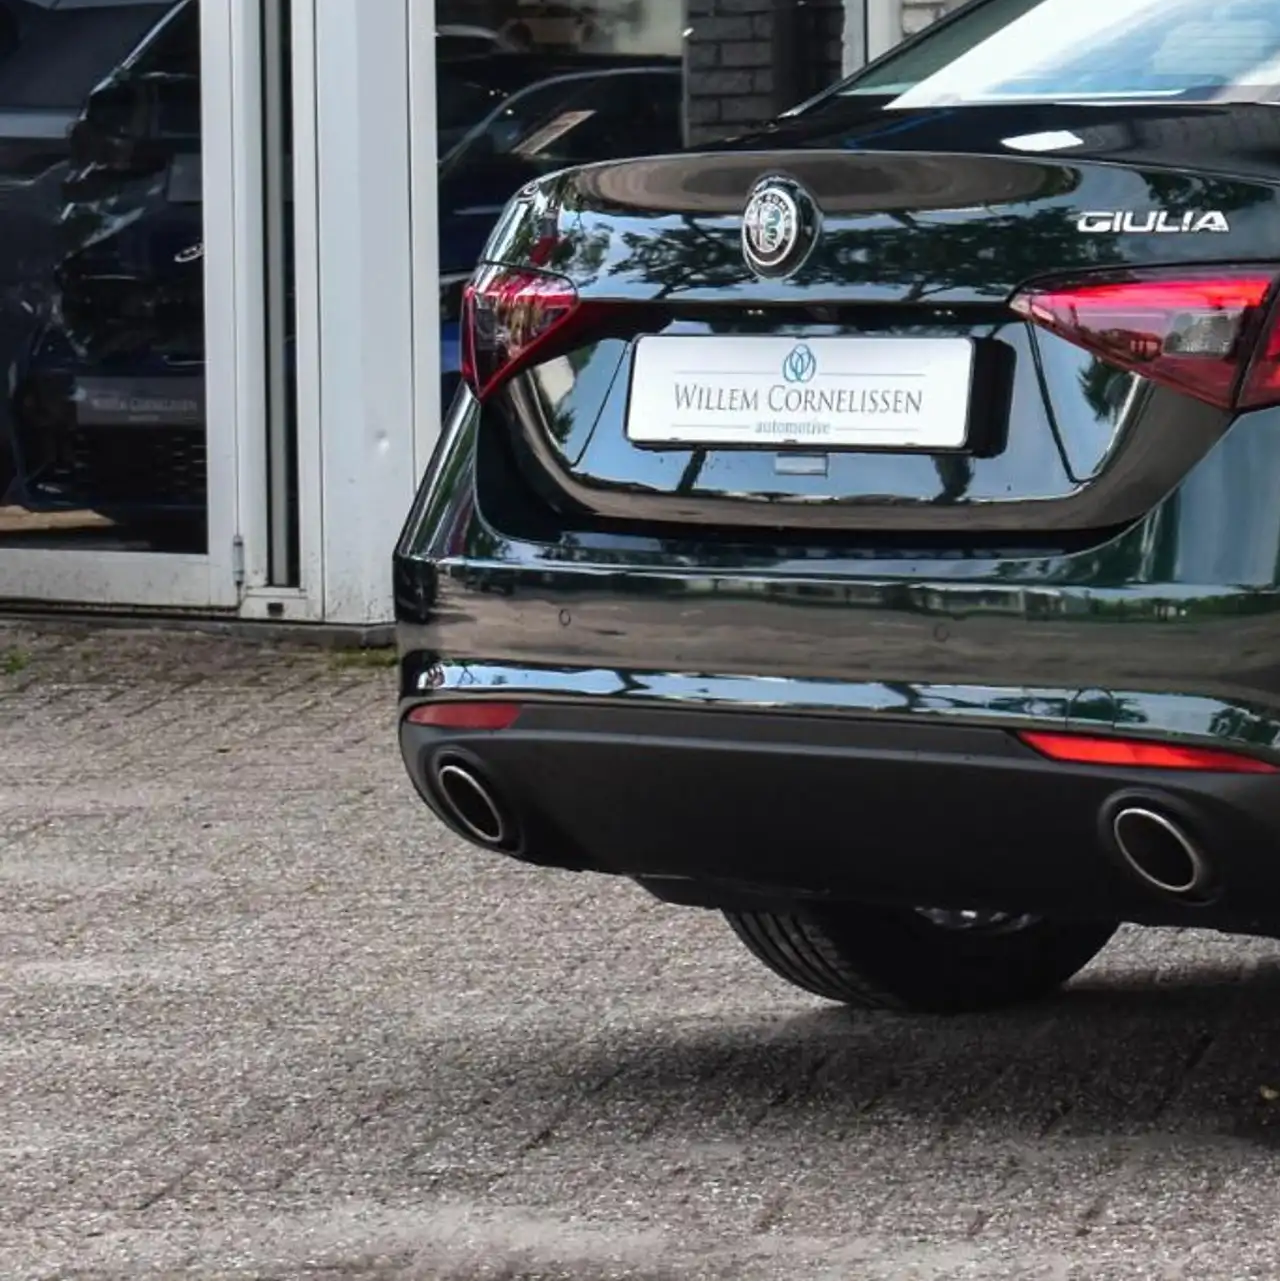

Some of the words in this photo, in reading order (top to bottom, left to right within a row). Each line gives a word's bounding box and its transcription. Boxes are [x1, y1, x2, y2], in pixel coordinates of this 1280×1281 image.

[1076, 210, 1230, 233] GIULIA
[674, 382, 760, 412] WILLEM
[767, 384, 924, 415] CORNELISSEN
[754, 419, 832, 436] automotive
